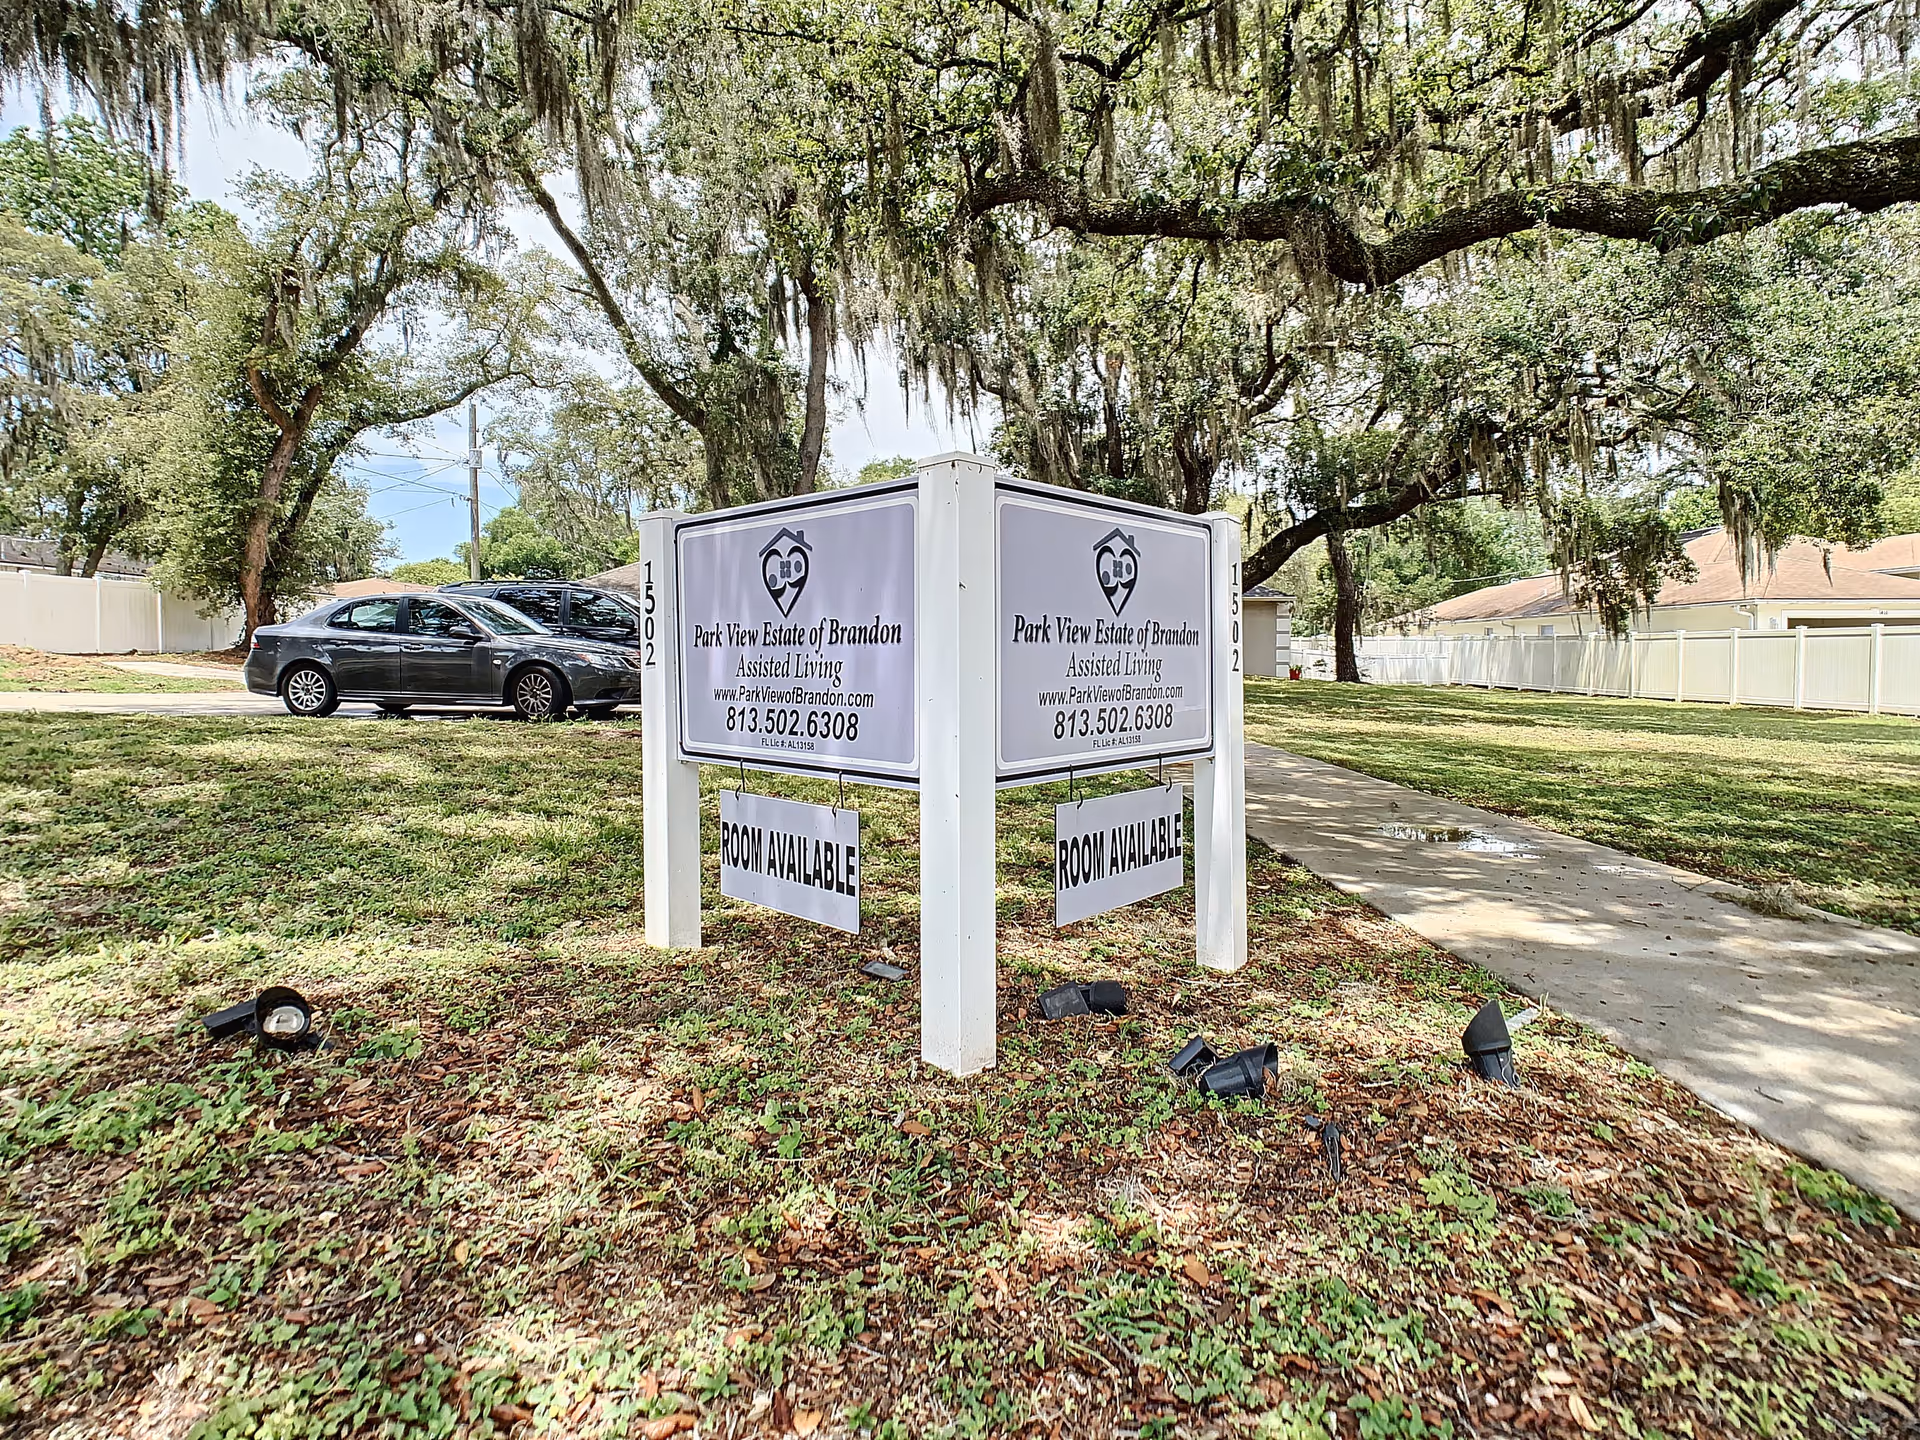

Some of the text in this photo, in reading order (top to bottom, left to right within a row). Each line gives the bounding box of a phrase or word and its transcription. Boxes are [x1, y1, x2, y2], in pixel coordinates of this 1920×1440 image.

[644, 561, 656, 666] 1502
[694, 615, 901, 653] Park View Estate of Brandon
[1013, 615, 1199, 651] Park View Estate of Brandon
[736, 652, 843, 687] Assisted Living
[1066, 651, 1162, 682] Assisted Living
[714, 686, 873, 707] www.ParkViewofBrandon.com
[1039, 684, 1183, 706] www.ParkViewofBrandon.com
[727, 707, 859, 741] 813.502.6308
[1054, 704, 1173, 739] 813.502.6308
[762, 738, 769, 746] FL
[771, 739, 779, 747] Lic
[788, 740, 814, 750] AL13158
[1093, 740, 1101, 748] FL
[1102, 739, 1110, 747] Lic
[722, 821, 855, 897] ROOM AVAILABLE
[1059, 813, 1181, 891] ROOM AVAILABLE
